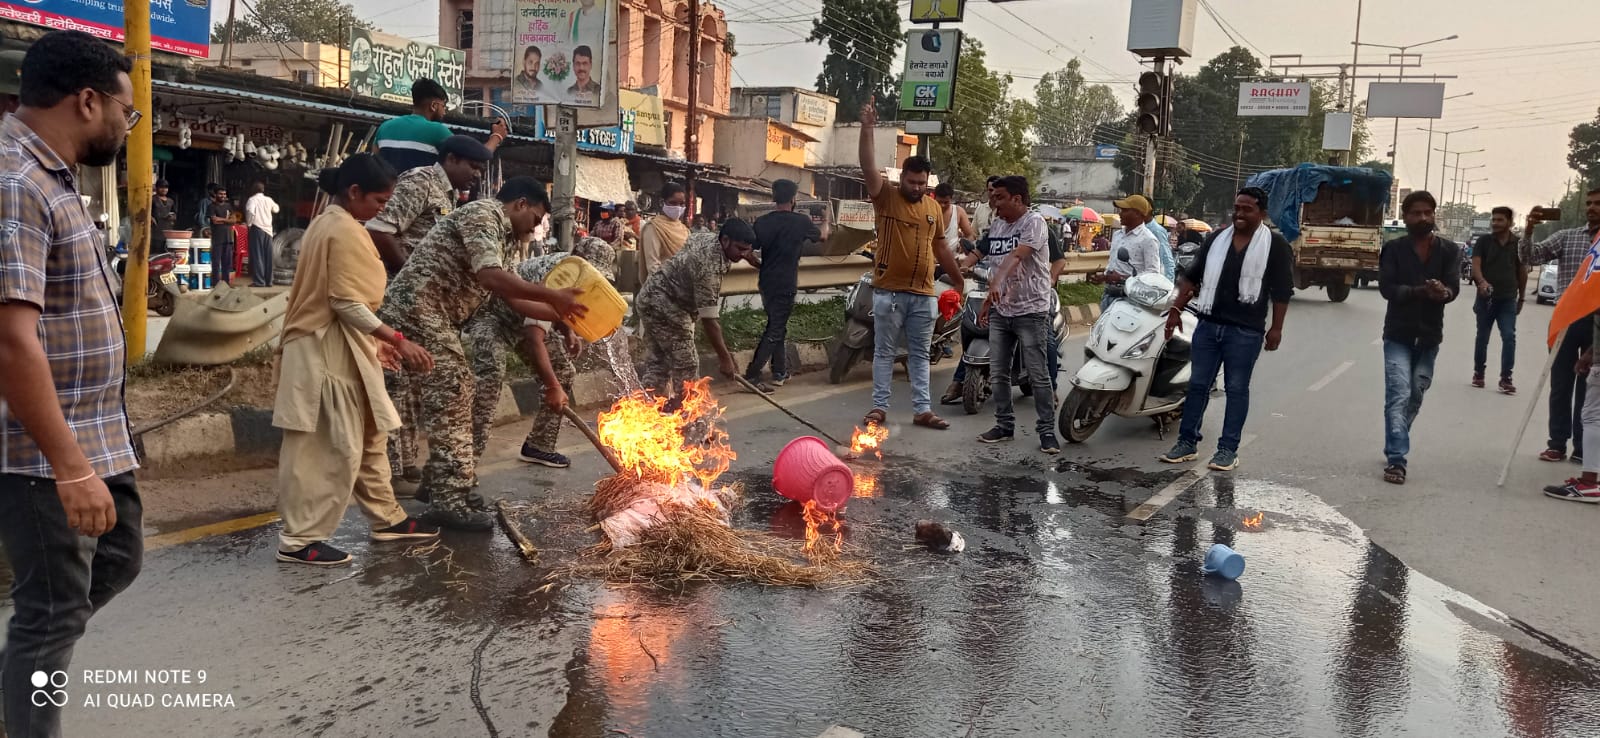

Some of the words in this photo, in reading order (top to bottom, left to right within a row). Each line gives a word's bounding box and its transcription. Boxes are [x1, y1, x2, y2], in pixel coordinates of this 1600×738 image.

[372, 46, 404, 88] राहुल
[437, 53, 463, 89] स्टोर
[915, 85, 937, 98] GK
[589, 128, 617, 148] STORE
